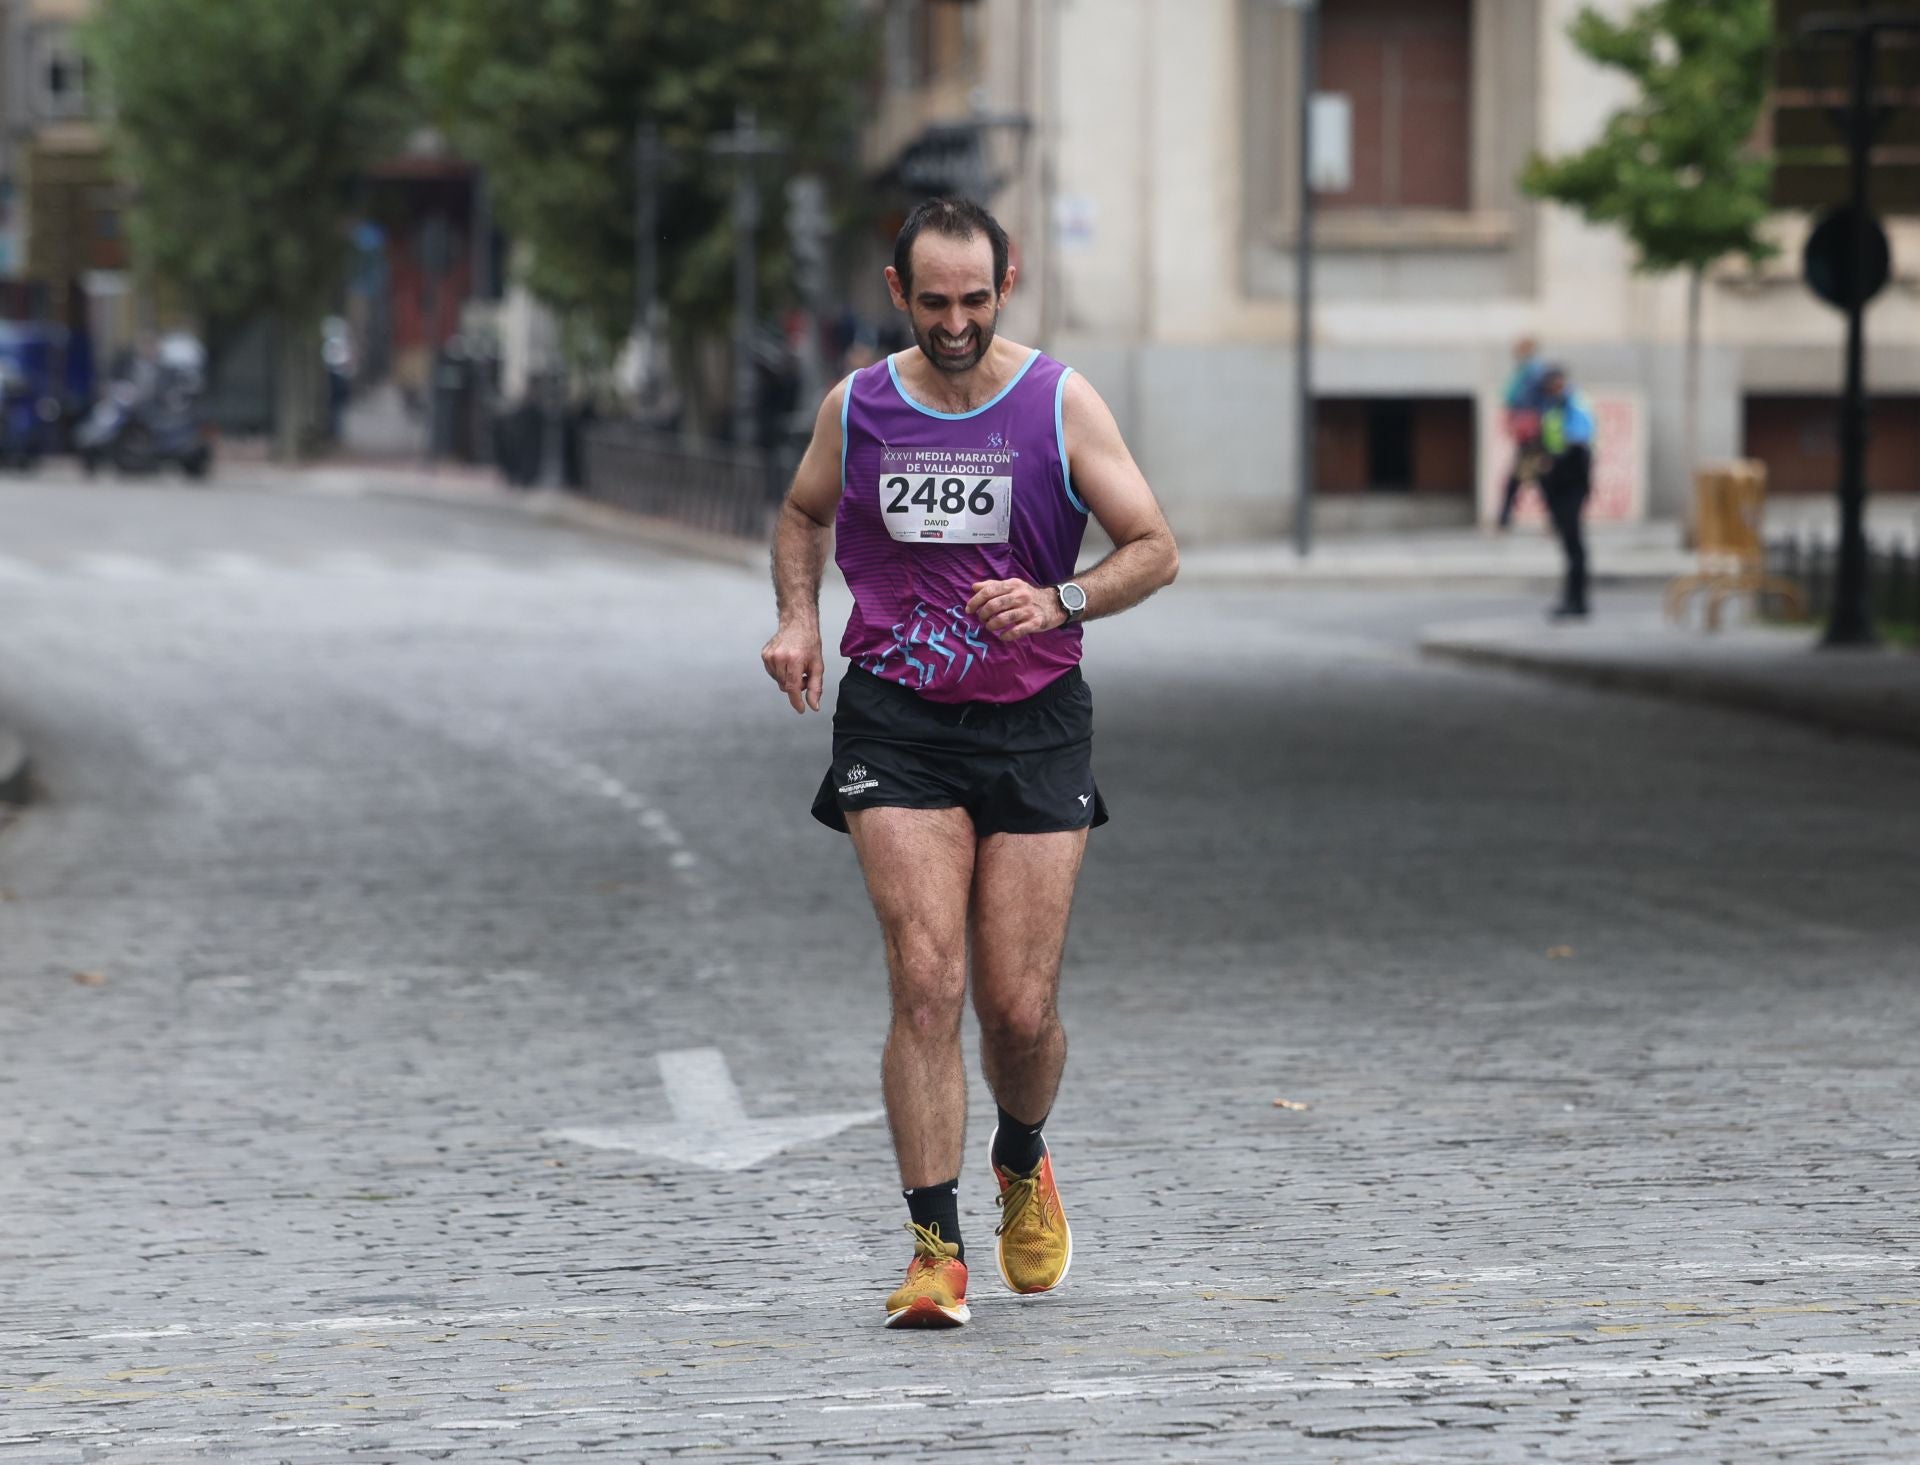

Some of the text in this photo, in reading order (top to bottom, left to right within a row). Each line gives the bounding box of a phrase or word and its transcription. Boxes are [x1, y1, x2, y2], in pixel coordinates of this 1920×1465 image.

[884, 452, 912, 461] XXXVI
[915, 452, 952, 461] MEDIA
[955, 452, 1010, 463] MARATÓN
[906, 463, 994, 474] DE VALLADOLID
[886, 476, 994, 515] 2486
[924, 519, 949, 527] DAVID
